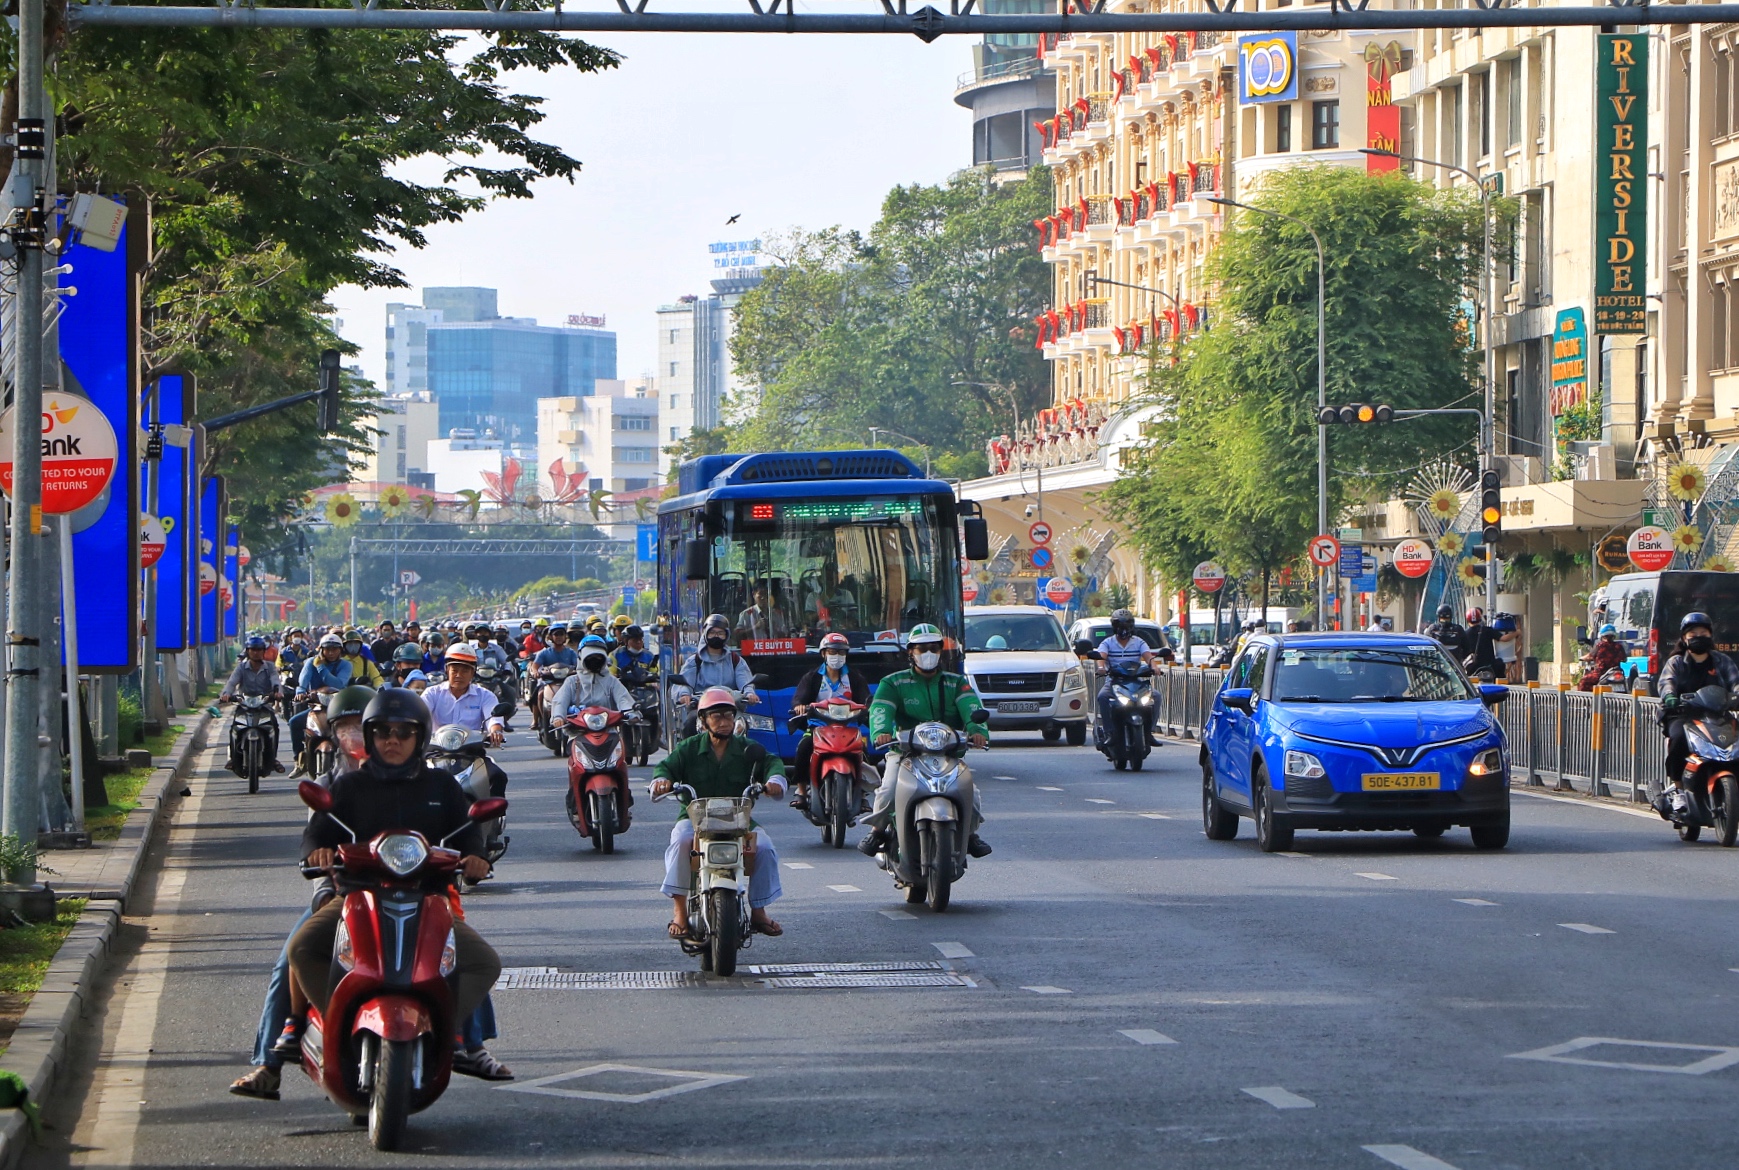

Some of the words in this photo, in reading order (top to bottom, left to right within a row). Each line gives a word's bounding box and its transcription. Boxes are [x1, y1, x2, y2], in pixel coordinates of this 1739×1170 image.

[1240, 38, 1291, 98] 100
[1367, 85, 1391, 107] NÂN
[1608, 38, 1636, 292] RIVERSIDE
[1597, 296, 1645, 307] HOTEL
[42, 435, 82, 456] ank
[63, 468, 76, 478] TO
[78, 467, 106, 478] YOUR
[46, 480, 88, 491] RETURNS
[1637, 532, 1653, 541] HD
[1402, 545, 1415, 553] HD
[1638, 541, 1662, 550] Bank
[1402, 552, 1422, 560] Bank
[753, 641, 764, 650] XE
[904, 697, 920, 705] Grab
[1369, 776, 1432, 788] 50E-437.81
